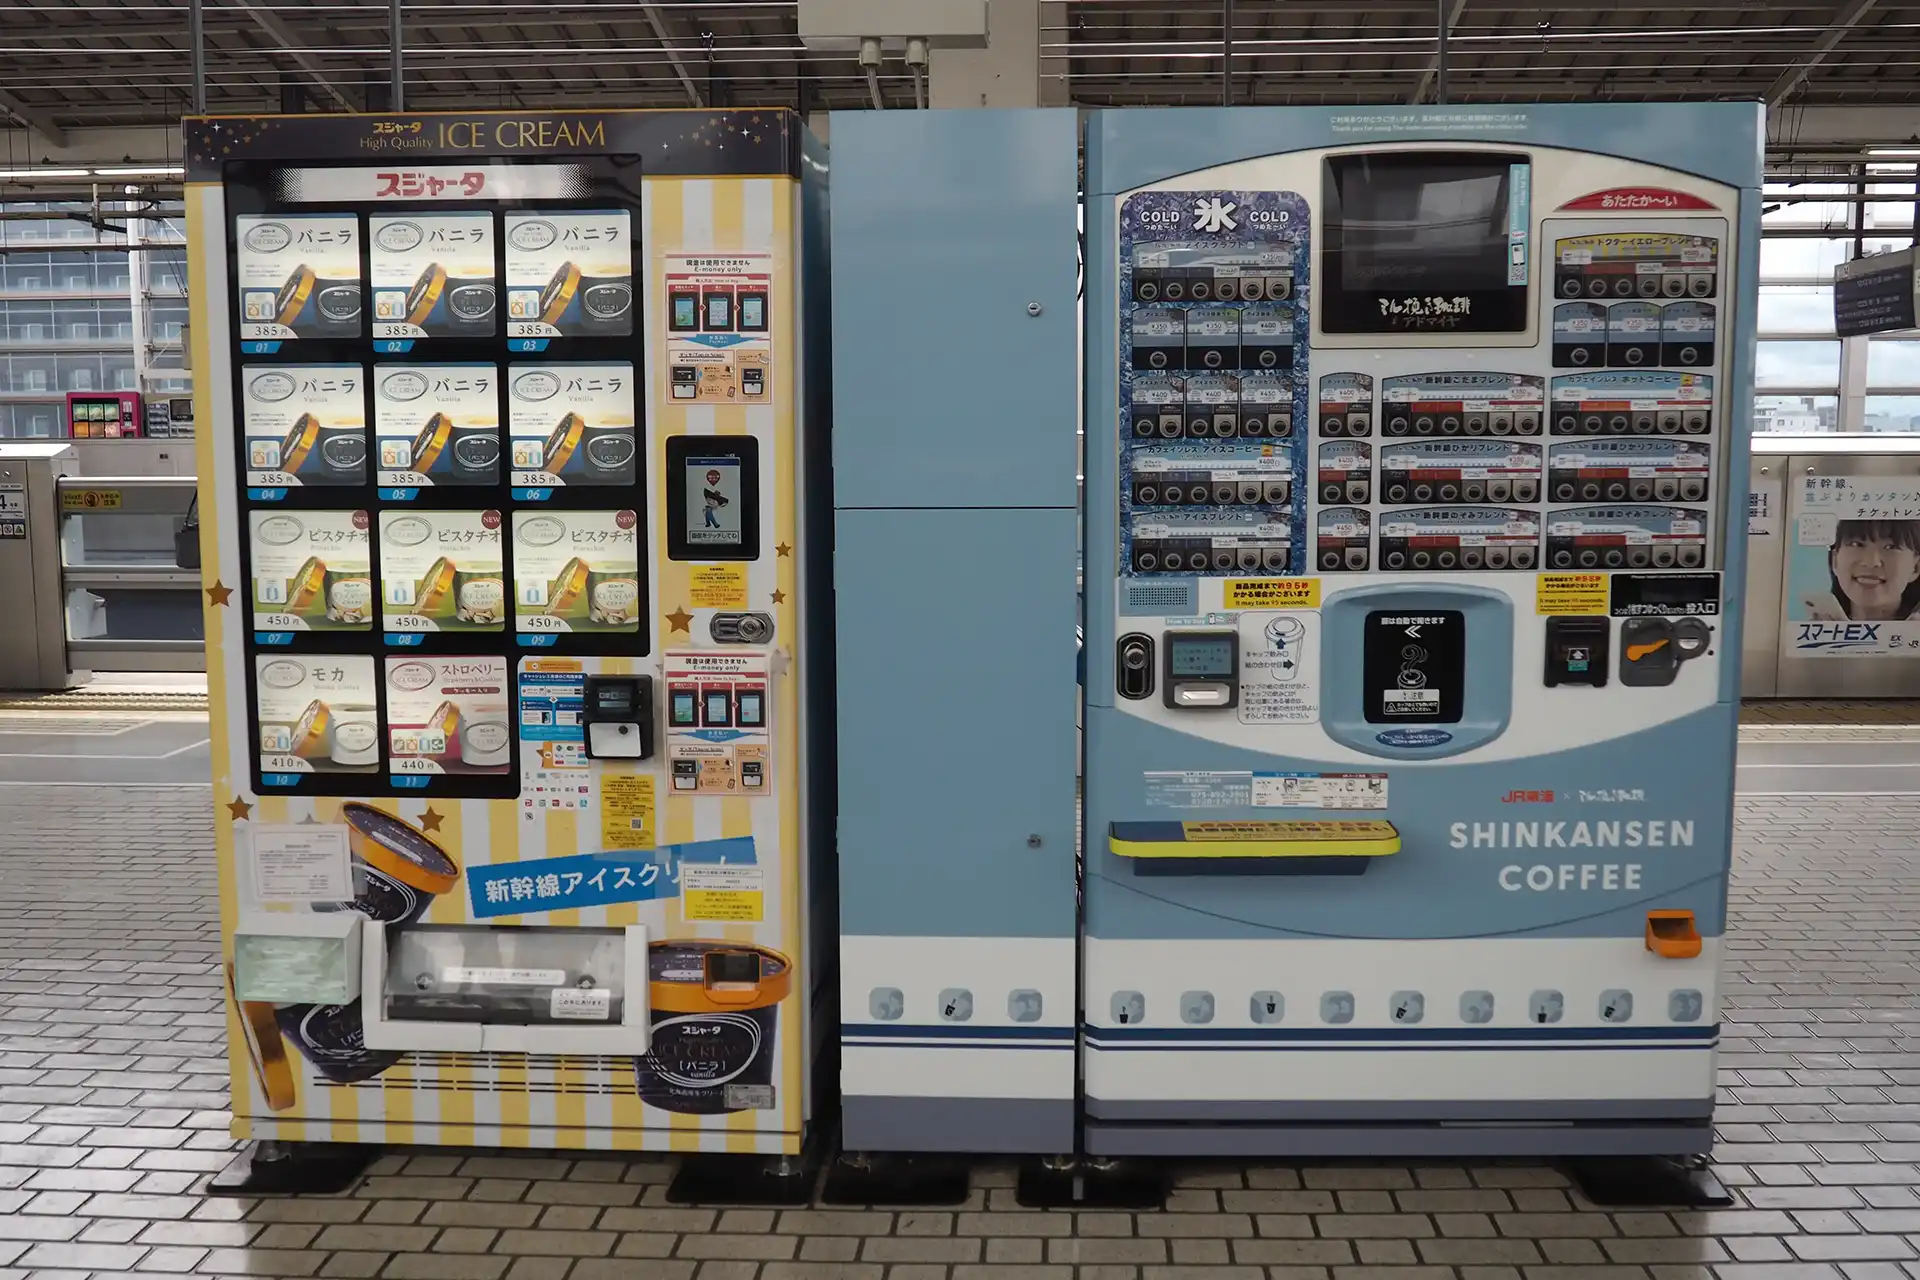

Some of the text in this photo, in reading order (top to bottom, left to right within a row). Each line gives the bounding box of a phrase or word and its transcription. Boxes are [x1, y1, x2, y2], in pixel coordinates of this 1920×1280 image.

[373, 122, 422, 134] スジャータ
[440, 121, 605, 148] ICE CREAM
[360, 137, 433, 151] High Quality
[376, 172, 485, 196] スジャータ
[1141, 212, 1180, 222] COLD
[1193, 198, 1238, 232] 氷
[1250, 212, 1289, 222] COLD
[298, 230, 351, 244] バニラ
[428, 228, 484, 242] バニラ
[562, 227, 619, 242] バニラ
[1185, 241, 1245, 249] アイスクラフト
[256, 343, 268, 352] 01
[388, 342, 402, 352] 02
[523, 341, 536, 350] 03
[301, 379, 355, 393] バニラ
[434, 378, 489, 393] バニラ
[566, 378, 622, 393] バニラ
[1203, 445, 1261, 453] アイスコーヒー
[1806, 478, 1853, 488] 新幹線、
[262, 490, 275, 499] 04
[392, 490, 405, 499] 05
[526, 490, 540, 499] 06
[309, 530, 368, 542] ピスタチオ
[438, 530, 500, 543] ピスタチオ
[572, 530, 635, 543] ピスタチオ
[1233, 590, 1310, 598] かかる場合がございます
[1686, 604, 1715, 613] 投入口
[268, 634, 280, 643] 07
[1797, 624, 1881, 641] スマートEX
[399, 635, 412, 645] 08
[532, 635, 544, 645] 09
[312, 667, 344, 681] モカ
[440, 664, 504, 676] ストロベリー
[1450, 820, 1694, 848] SHINKANSEN
[364, 874, 390, 893] スジャータ
[485, 857, 722, 904] 新幹線アイスクリ
[1498, 864, 1642, 891] COFFEE
[682, 1026, 721, 1035] スジャータ
